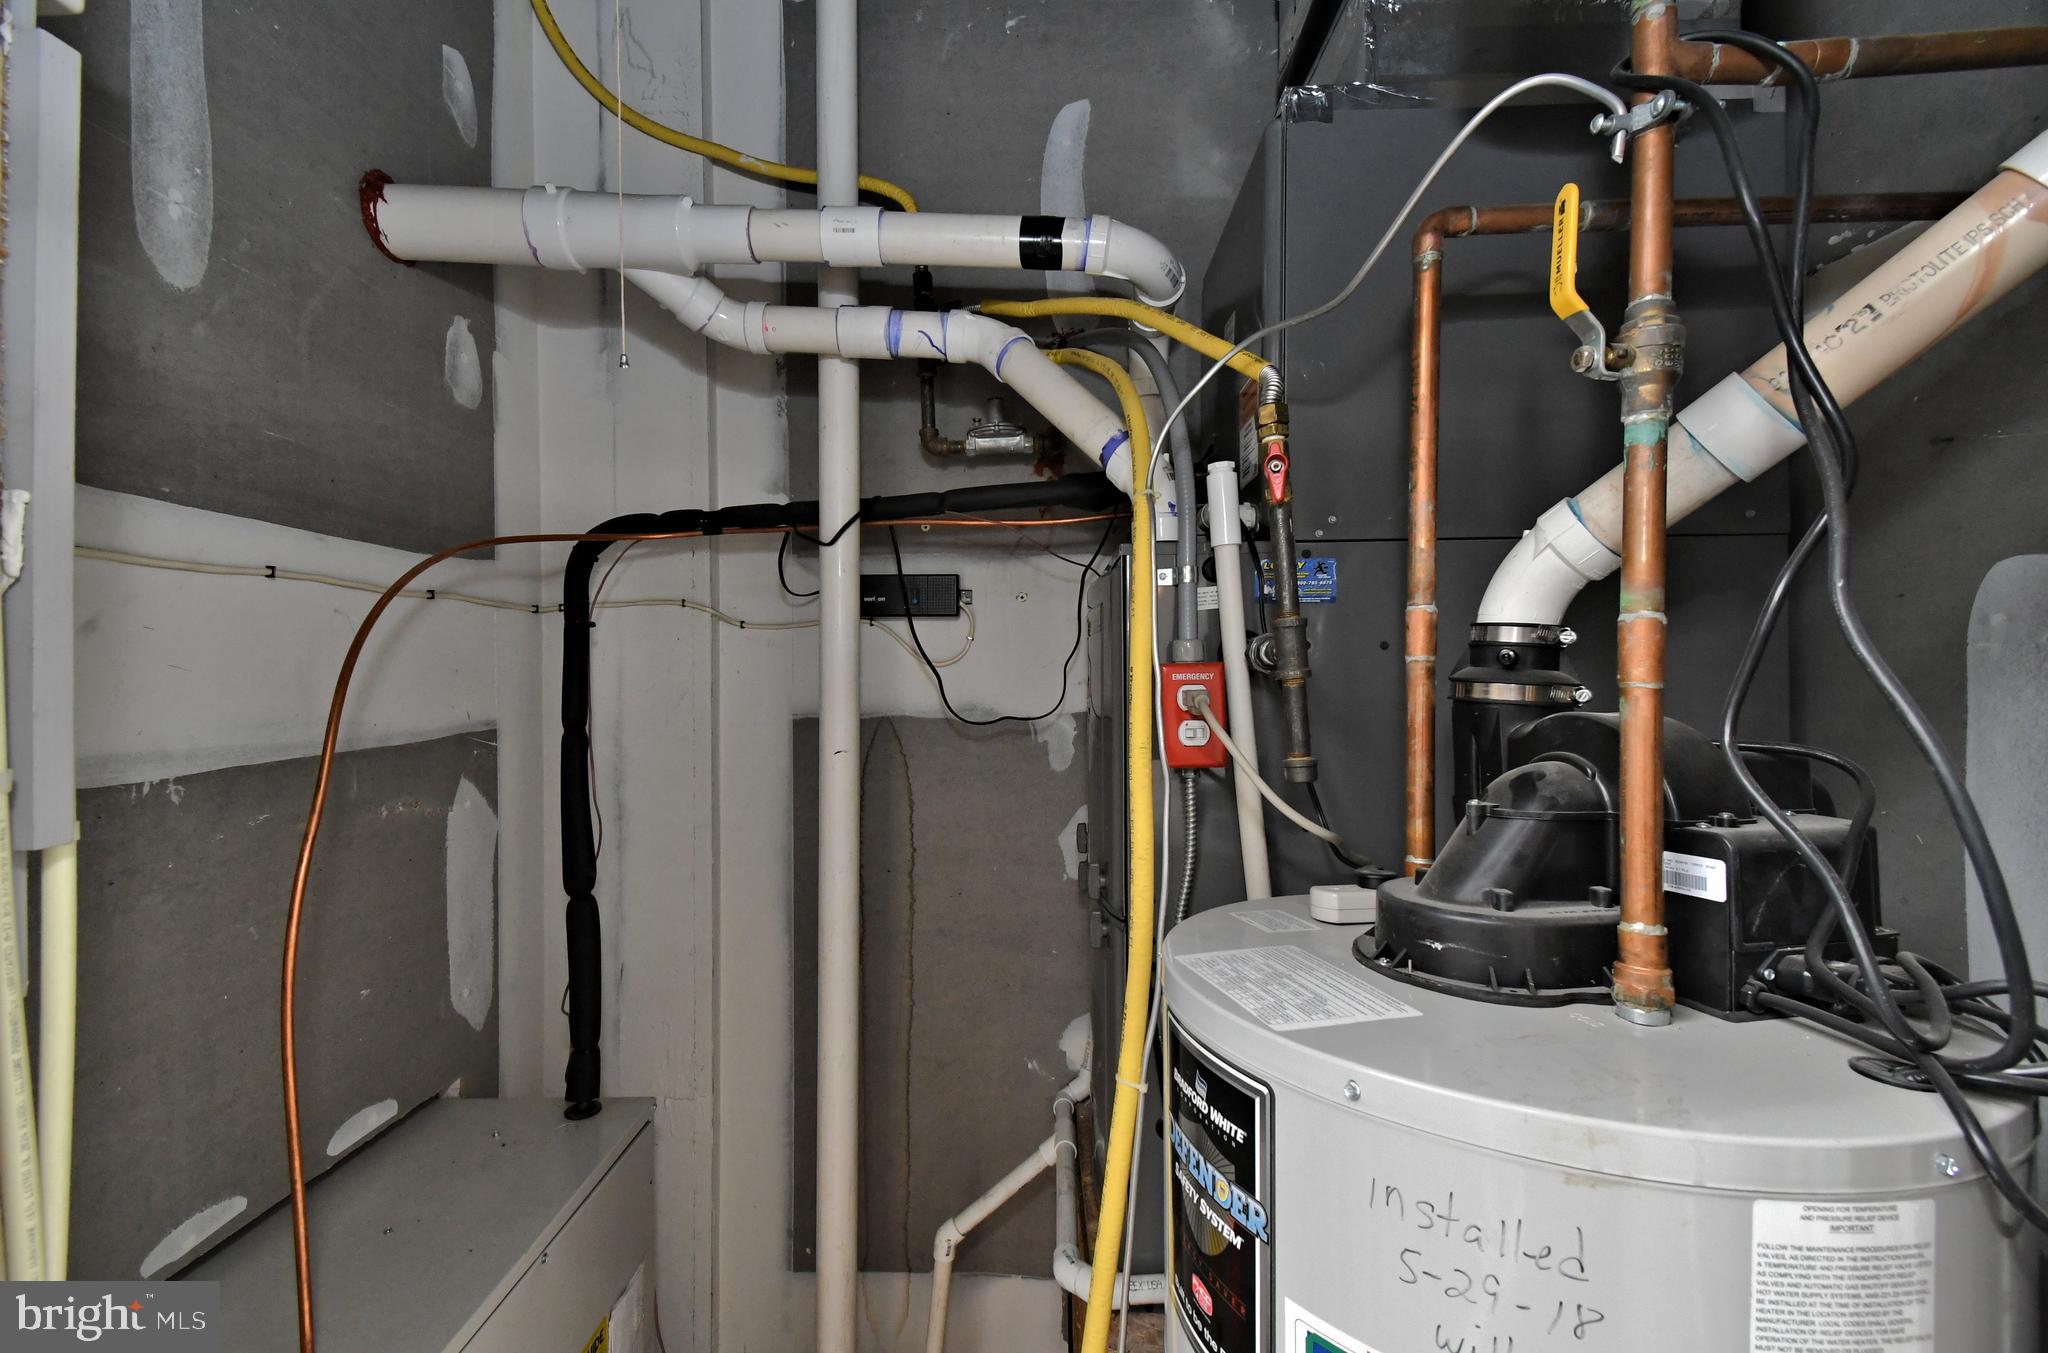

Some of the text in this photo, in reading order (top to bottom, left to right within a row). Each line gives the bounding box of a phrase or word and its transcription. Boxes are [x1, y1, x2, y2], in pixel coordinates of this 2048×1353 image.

[1555, 219, 1565, 275] MUELLER
[1172, 673, 1214, 681] EMERGENCY
[1174, 1067, 1208, 1115] BRADFORD
[1169, 1111, 1268, 1242] DEFENDER
[1175, 1161, 1199, 1204] SAFETY
[1768, 1271, 1811, 1279] COMPLYING
[1768, 1299, 1807, 1307] INSTALLED
[1192, 1310, 1203, 1332] be
[1203, 1325, 1218, 1351] the
[1755, 1335, 1797, 1343] OPERATION
[1756, 1326, 1806, 1334] INSTALLATION
